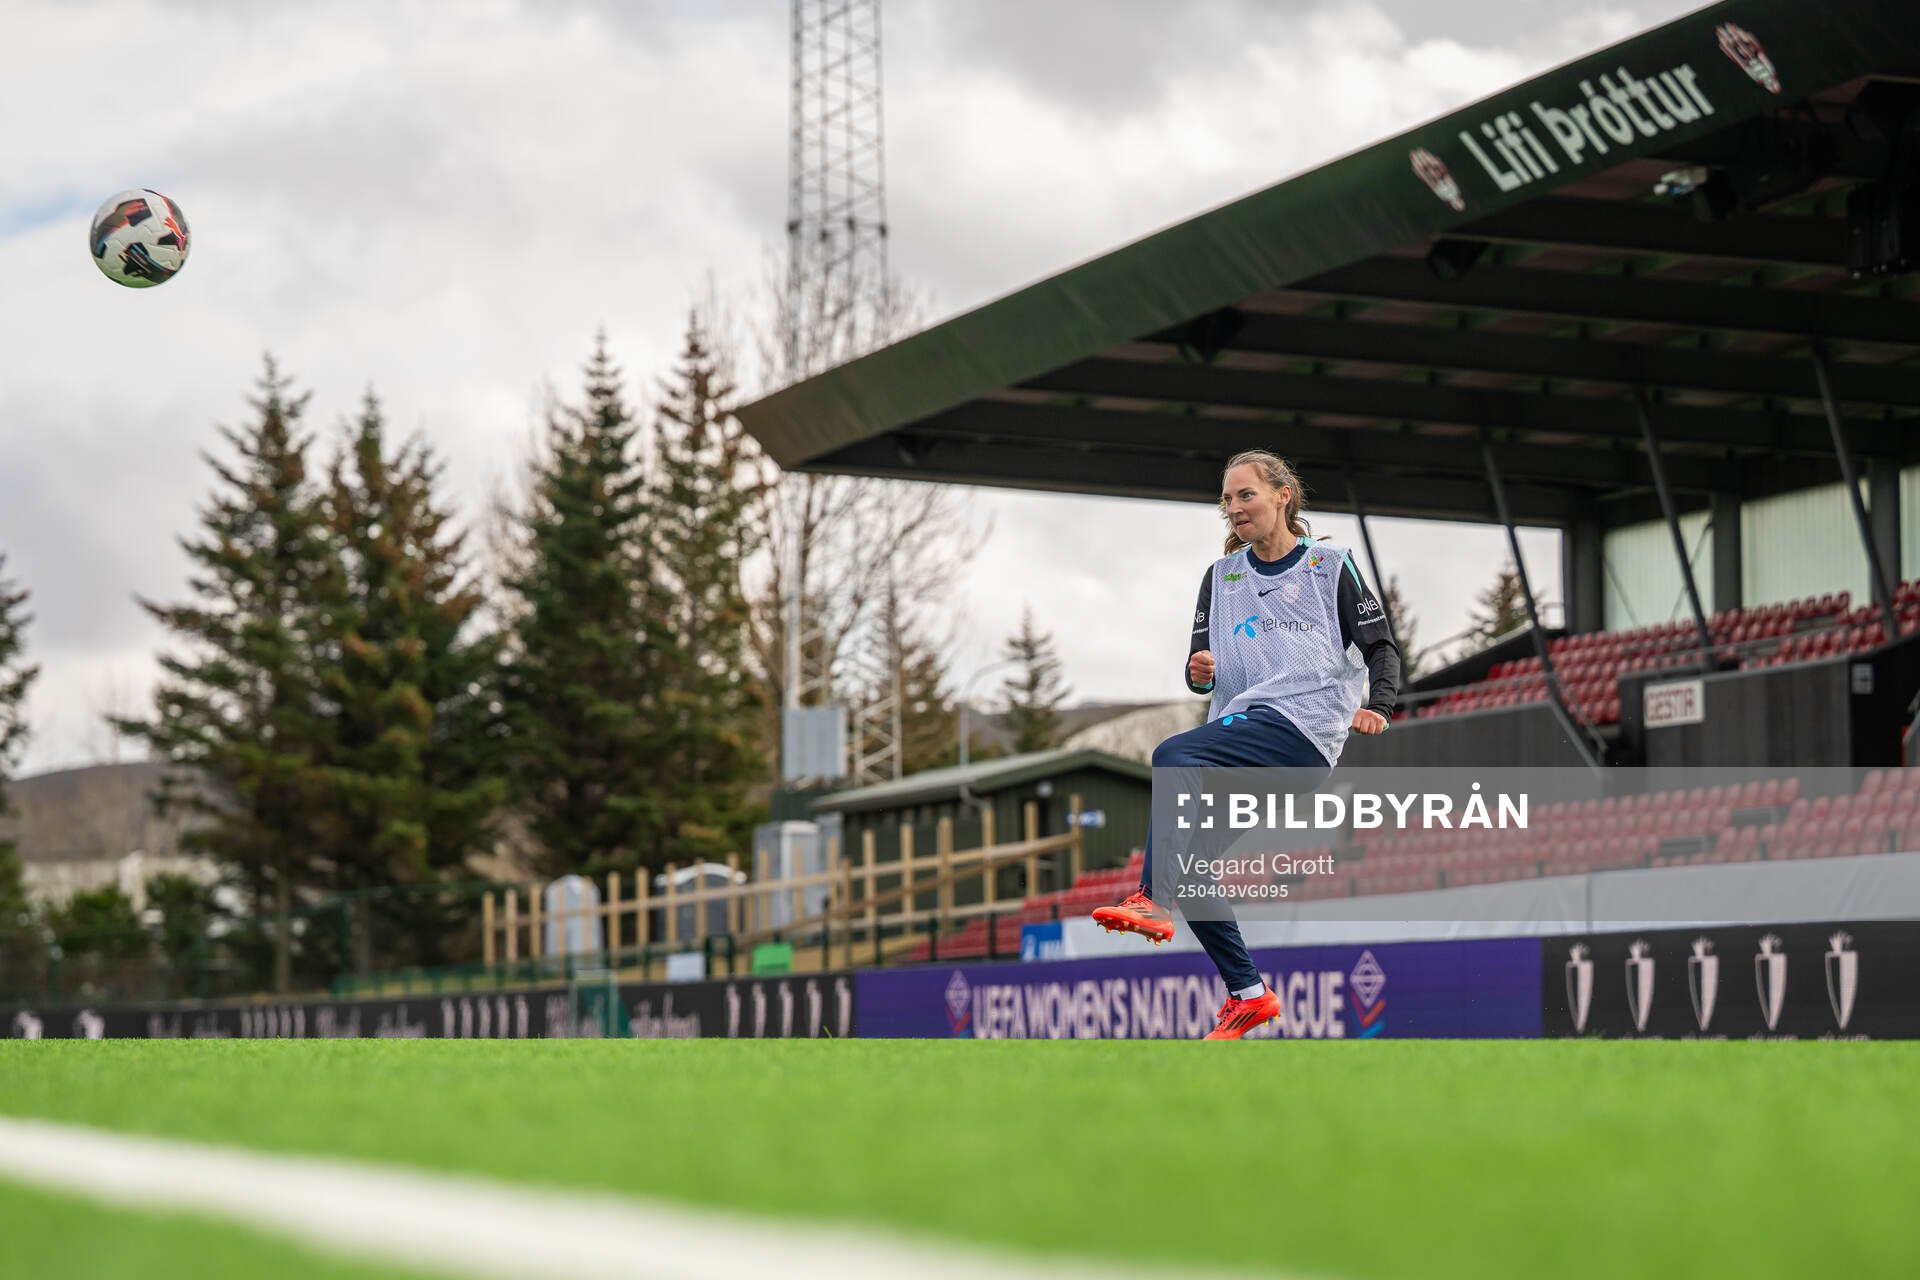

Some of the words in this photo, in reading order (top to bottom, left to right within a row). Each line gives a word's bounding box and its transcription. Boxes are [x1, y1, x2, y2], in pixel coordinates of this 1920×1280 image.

[1459, 112, 1560, 192] Lifi
[1357, 597, 1379, 616] DNB
[973, 984, 1026, 1038] UEFA
[1130, 976, 1226, 1038] NATION
